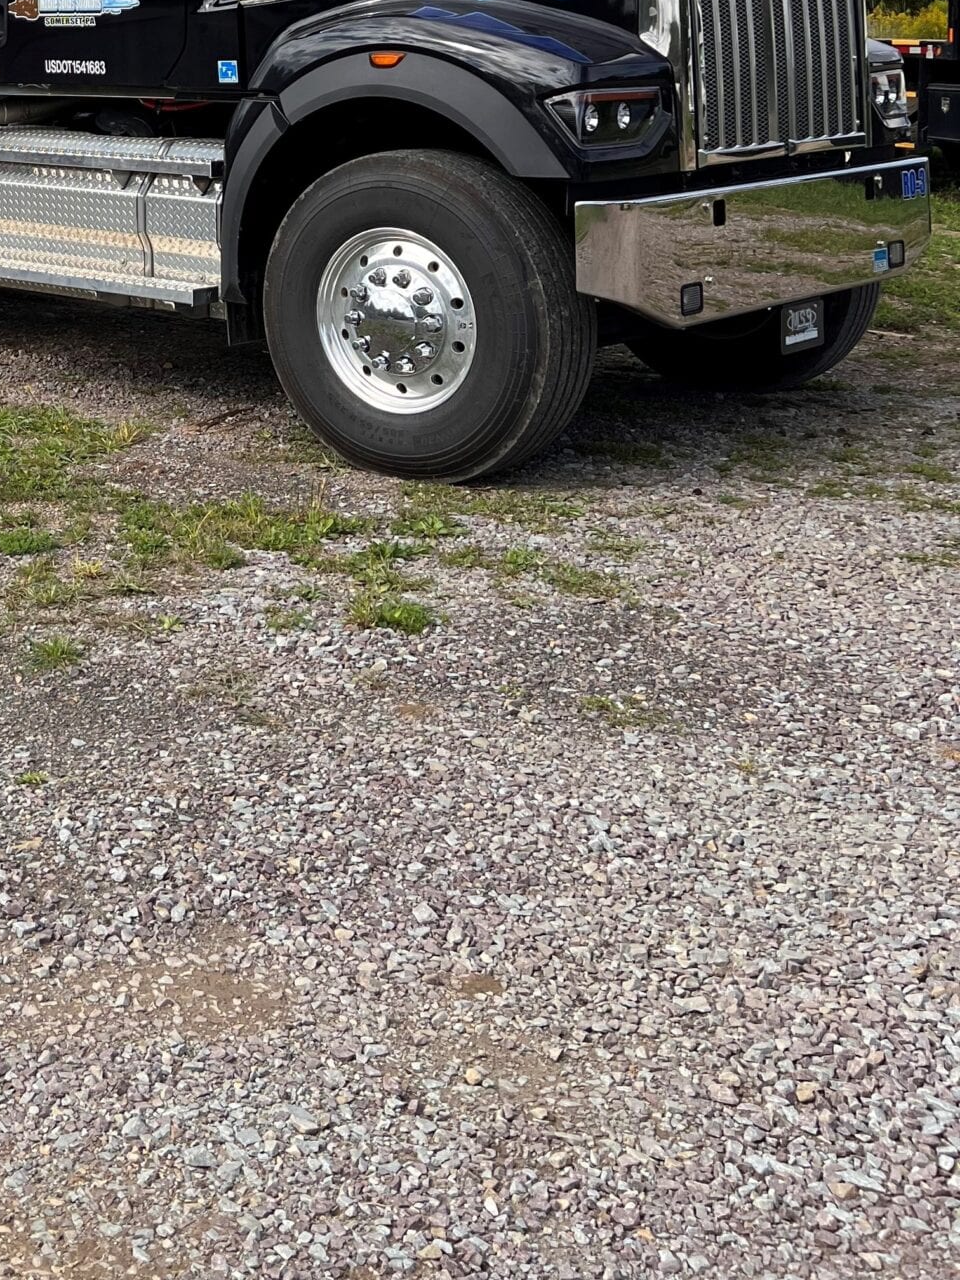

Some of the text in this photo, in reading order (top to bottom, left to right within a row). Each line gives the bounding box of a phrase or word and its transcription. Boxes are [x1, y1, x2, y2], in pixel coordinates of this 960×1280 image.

[85, 16, 96, 26] PA
[44, 59, 107, 75] USDOT1541683
[901, 168, 927, 200] RO-3
